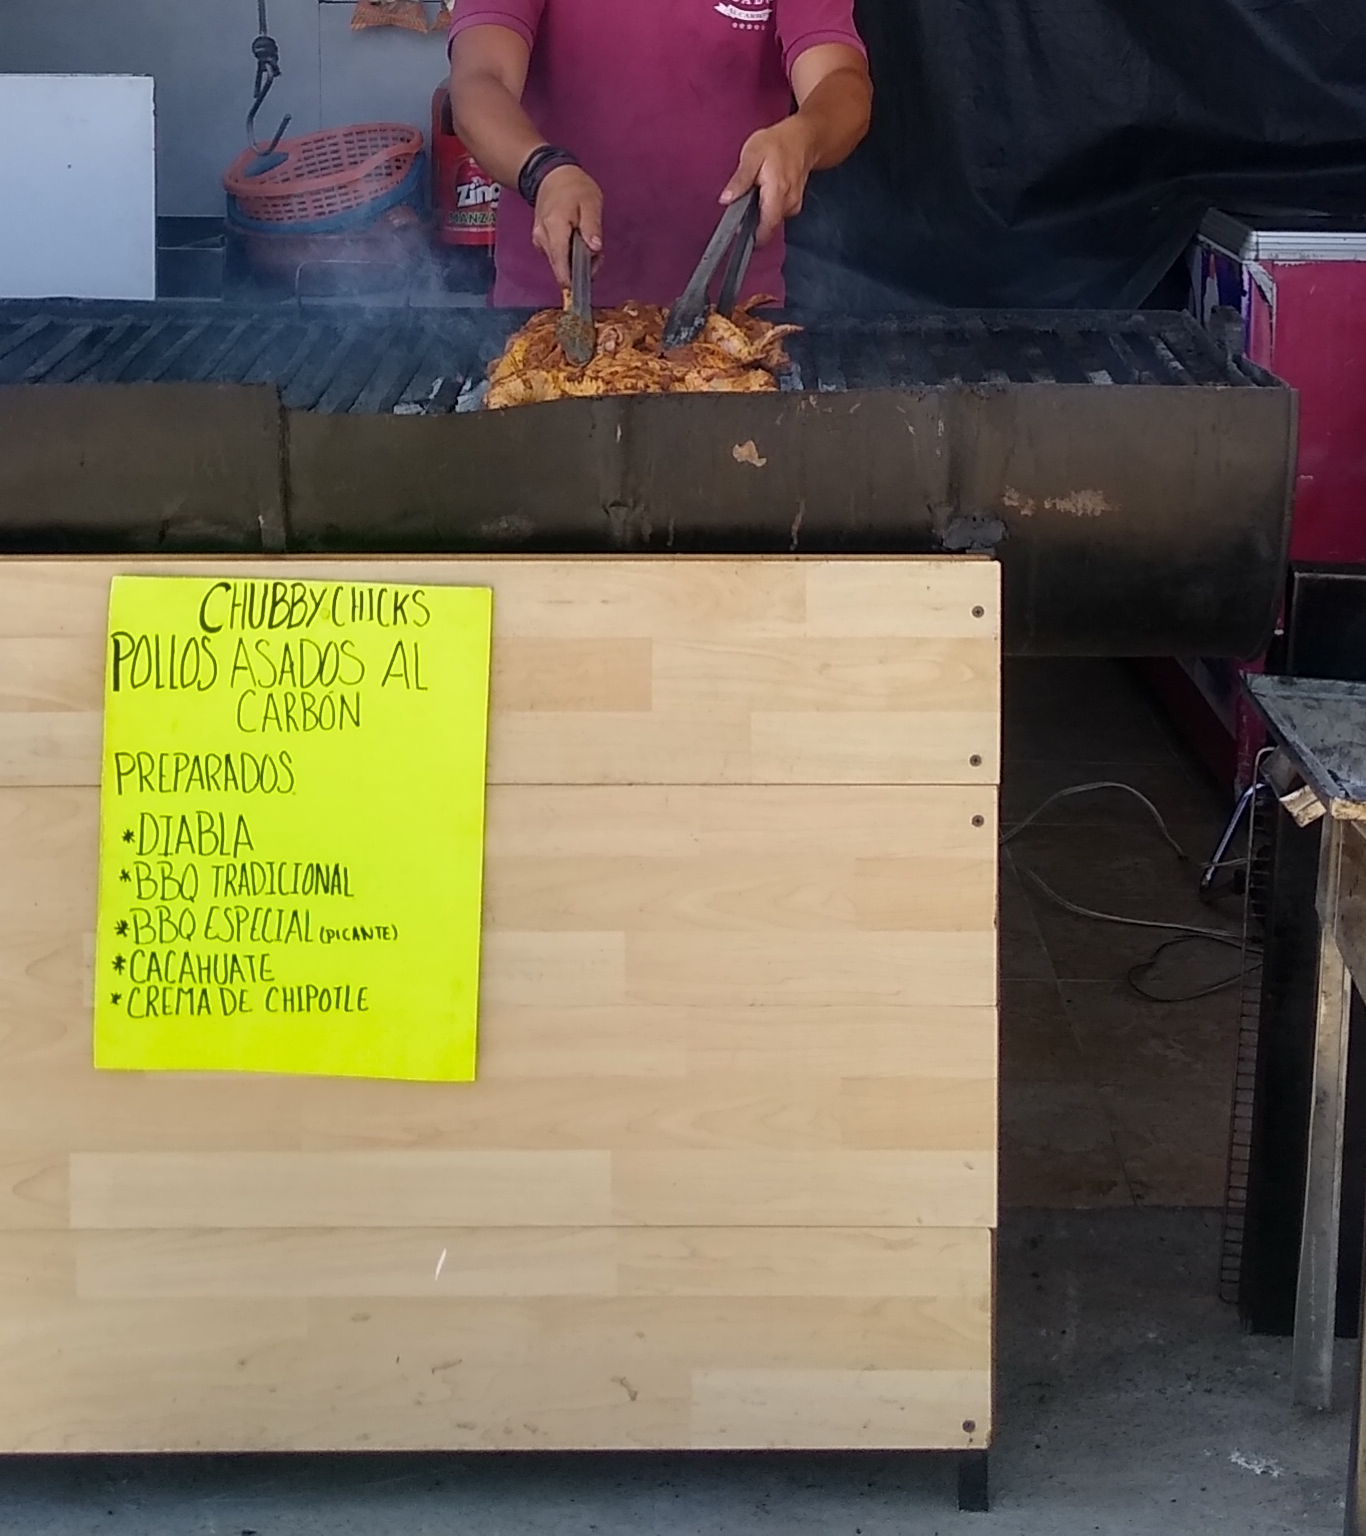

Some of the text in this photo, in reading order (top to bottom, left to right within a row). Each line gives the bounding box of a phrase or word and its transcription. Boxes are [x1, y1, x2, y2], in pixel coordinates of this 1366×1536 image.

[199, 582, 431, 634] CHUBBY CHICKS
[110, 631, 429, 693] POLLOS ASADOS AL
[135, 810, 255, 859] DIABLA
[133, 861, 355, 903] BBQ TRADICIONAL
[129, 905, 398, 945] BBQ ESPECIAL (PICANTE)
[129, 949, 275, 986] CACAHUATE
[126, 984, 370, 1019] CREMA DE CHIPOTLE
